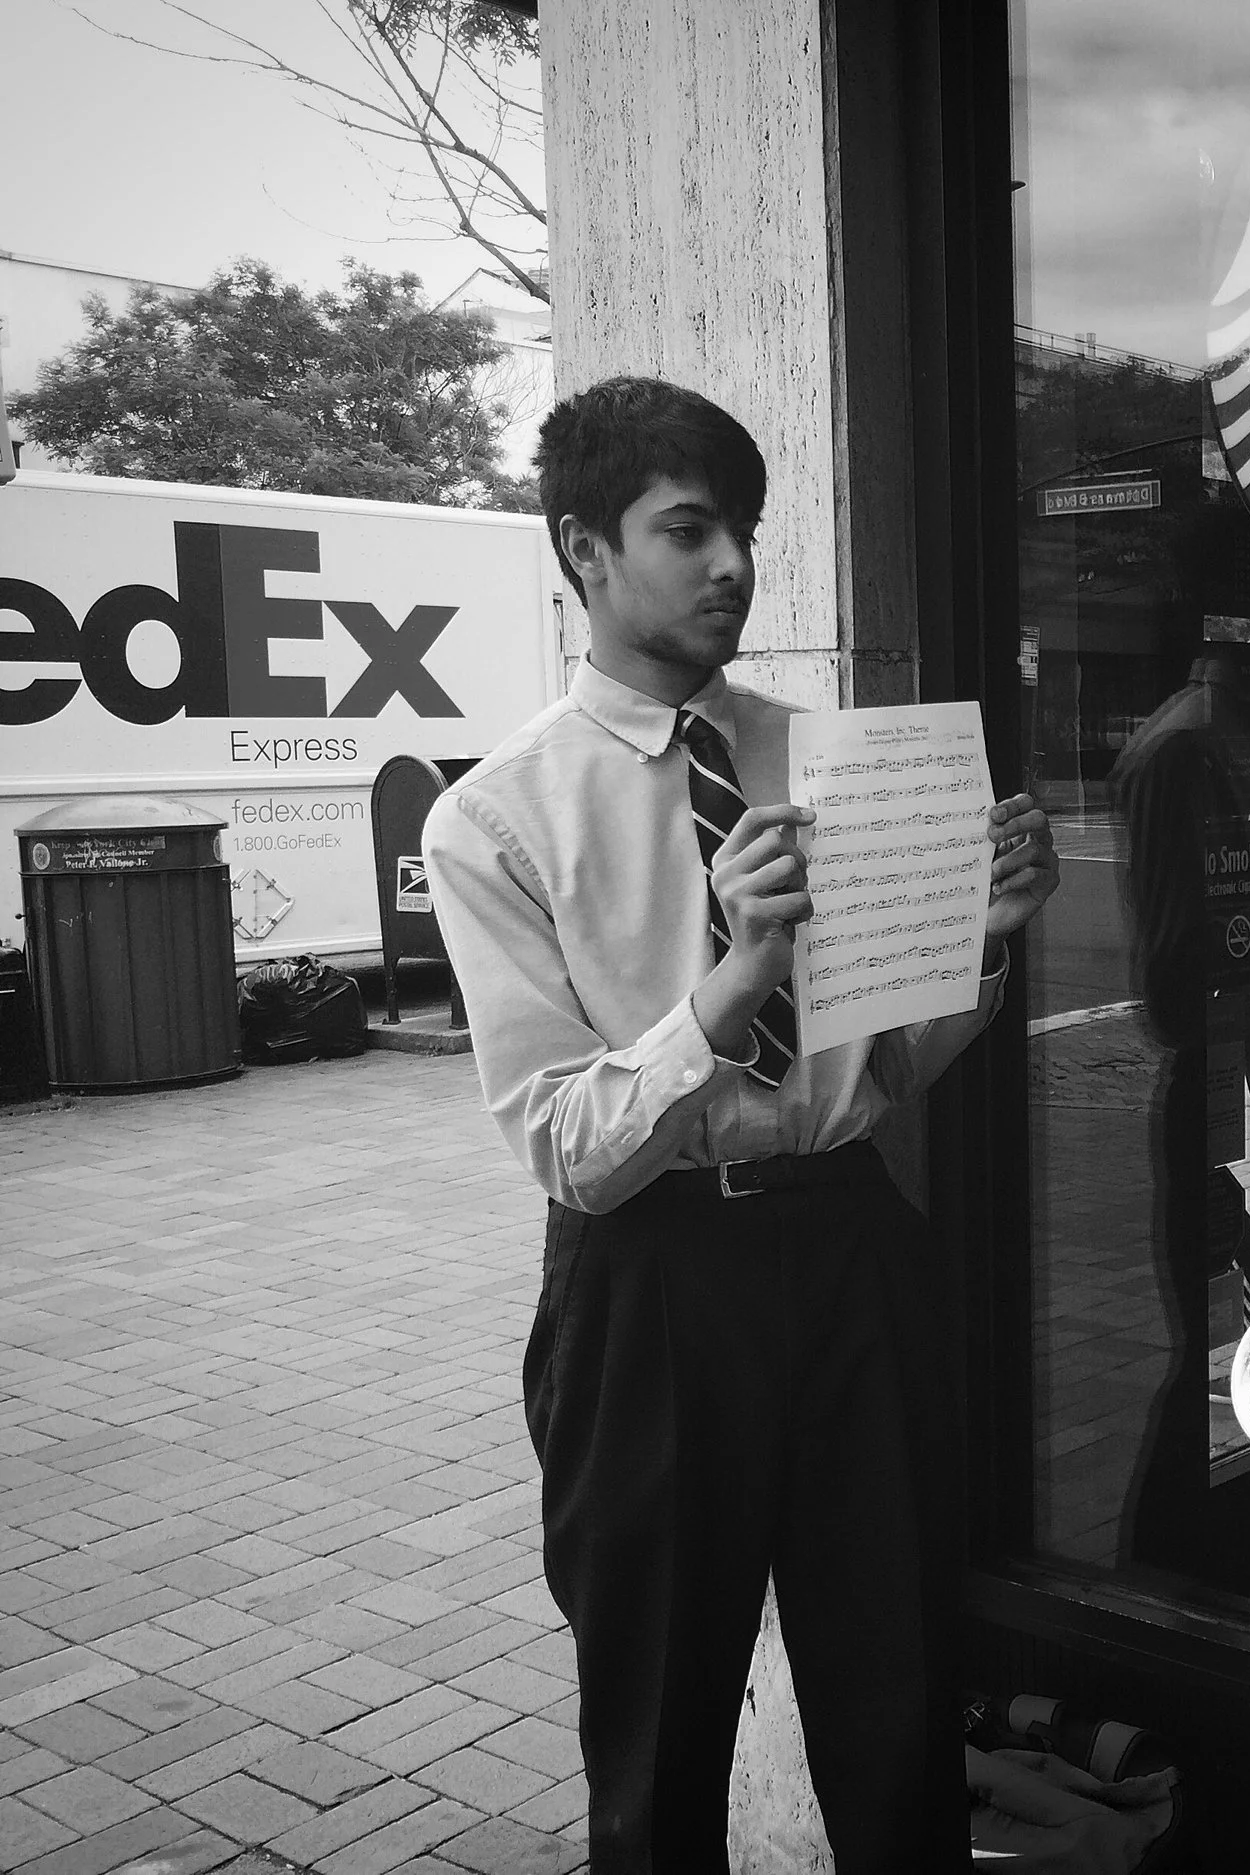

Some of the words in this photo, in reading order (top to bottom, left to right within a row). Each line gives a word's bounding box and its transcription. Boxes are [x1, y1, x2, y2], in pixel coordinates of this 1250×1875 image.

[231, 730, 358, 769] Express
[231, 798, 364, 825] fedex.com
[234, 833, 342, 852] 1.800.GoFedEx
[1204, 846, 1217, 877] o
